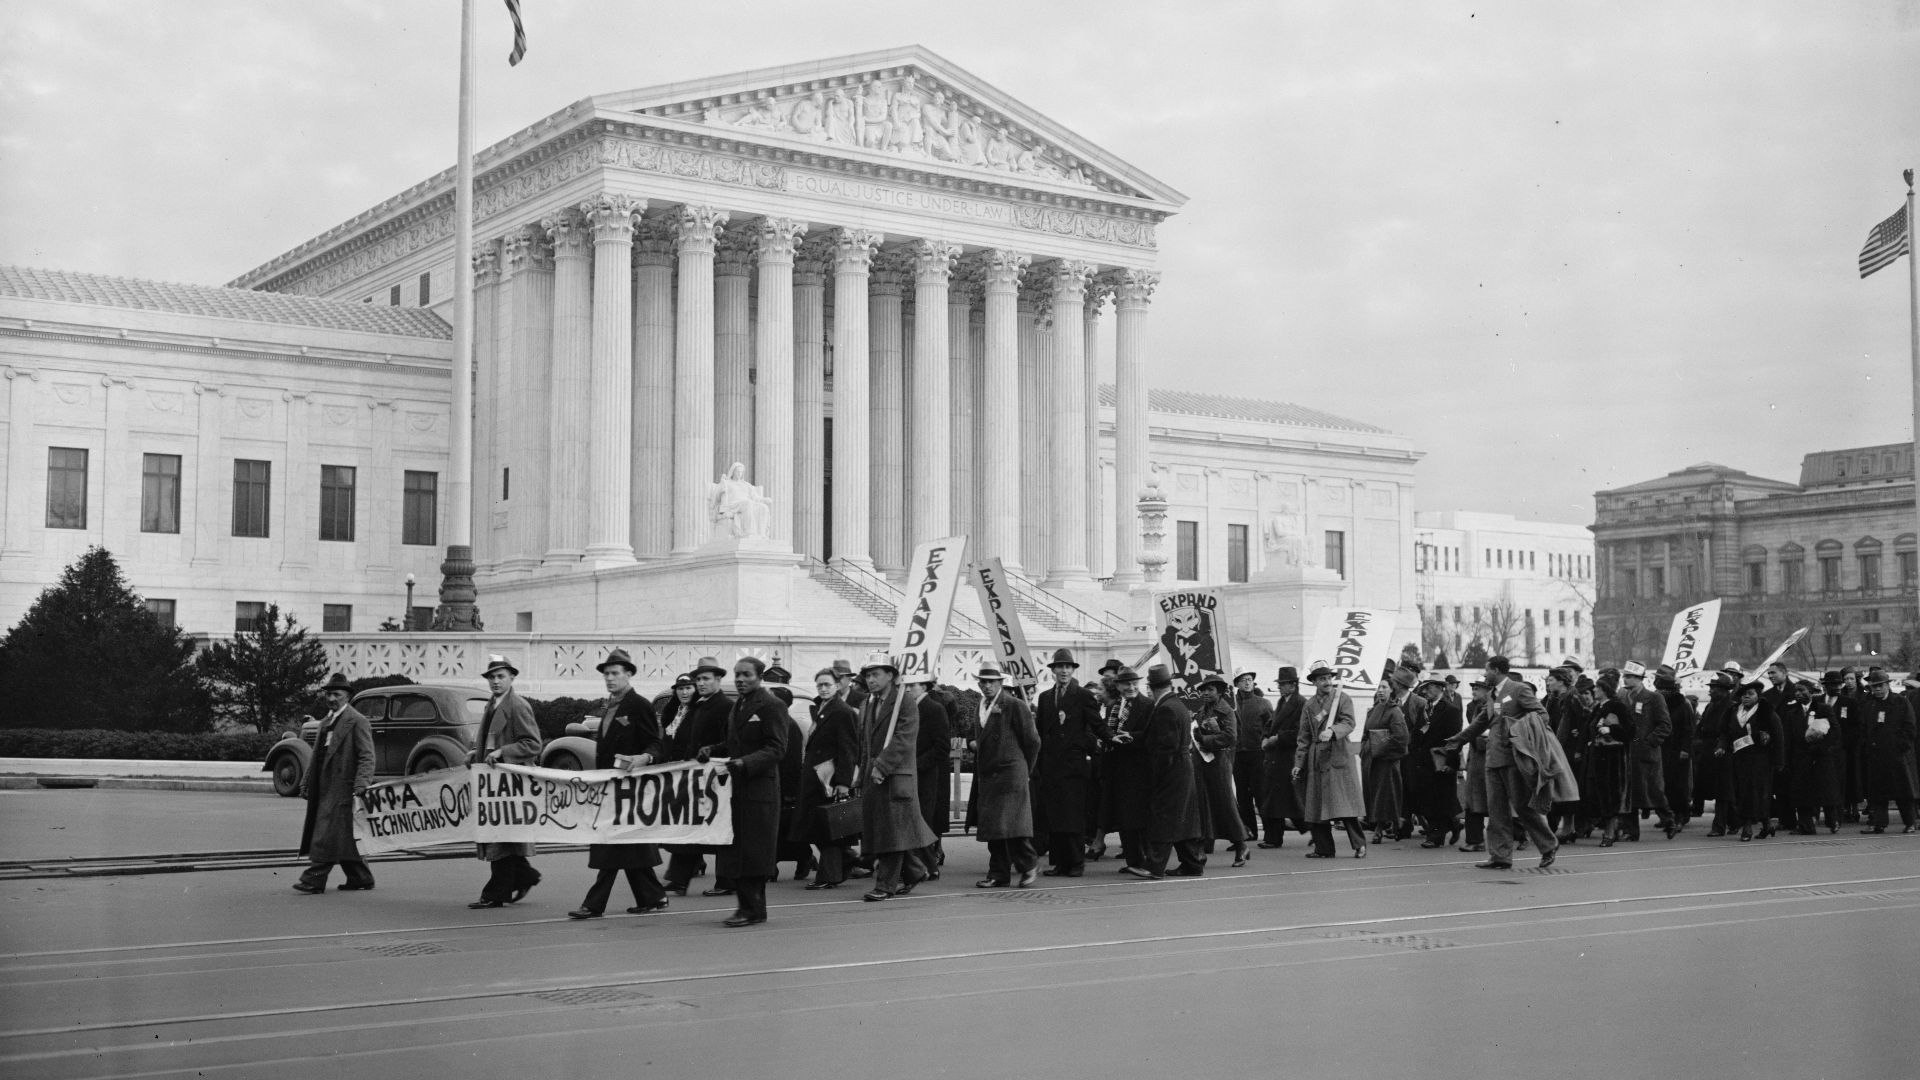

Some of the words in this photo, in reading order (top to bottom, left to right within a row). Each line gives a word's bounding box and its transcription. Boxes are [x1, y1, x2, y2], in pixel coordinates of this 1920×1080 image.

[796, 175, 851, 198] EQUAL
[853, 184, 914, 207] JUSTICE
[920, 193, 970, 216] UNDER
[975, 203, 1004, 220] LAW
[905, 547, 946, 648] EXPAND
[979, 568, 1016, 656] EXPAND
[1160, 592, 1217, 613] EXPAND
[1334, 611, 1372, 666] EXPAND
[1675, 607, 1704, 661] EXPAND
[1000, 656, 1034, 680] WPA
[1331, 668, 1373, 685] PA
[1672, 657, 1699, 675] PA
[478, 772, 524, 798] PLAN
[527, 774, 542, 797] &
[540, 779, 577, 830] Low
[570, 776, 608, 830] Cost
[610, 767, 729, 827] HOMES
[366, 807, 447, 838] TECHNICIANS
[478, 800, 538, 827] BUILD
